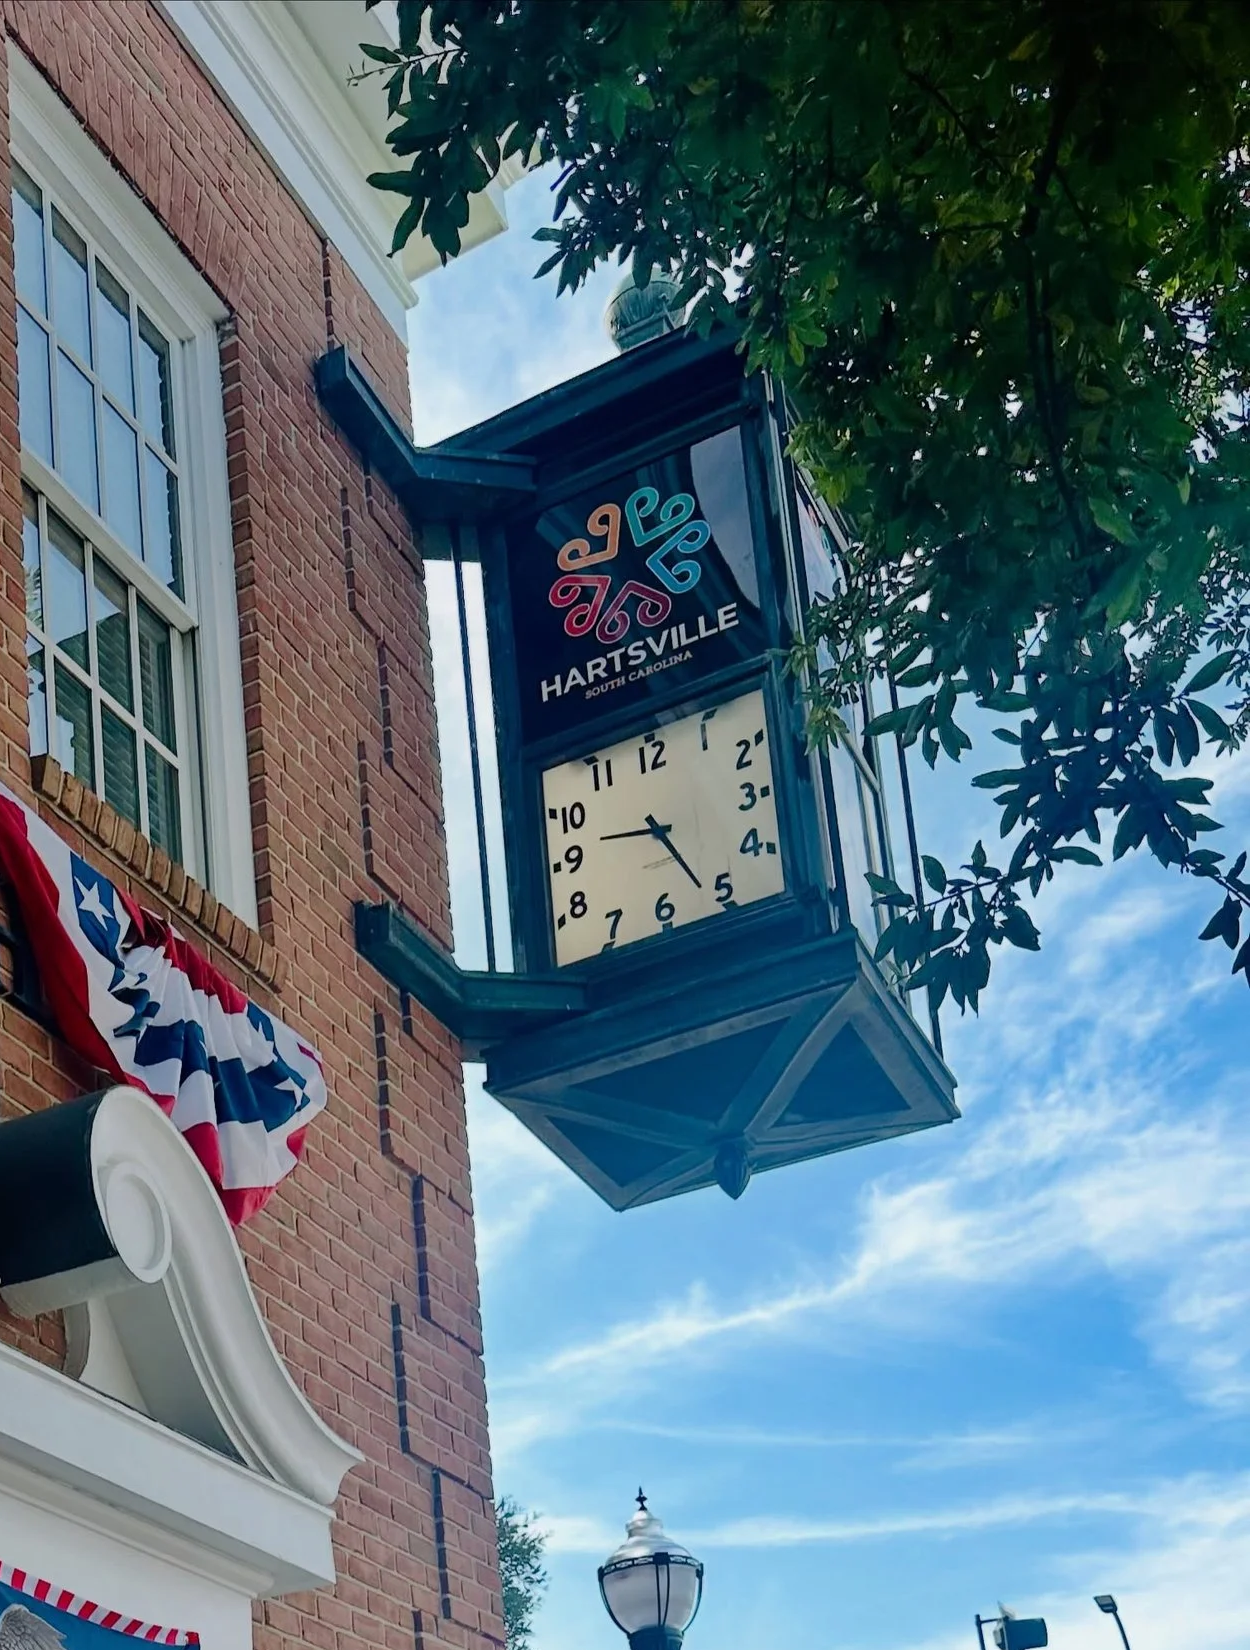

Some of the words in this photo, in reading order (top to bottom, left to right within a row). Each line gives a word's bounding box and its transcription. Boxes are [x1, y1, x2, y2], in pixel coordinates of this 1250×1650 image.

[541, 602, 739, 702] HARTSVILLE
[585, 676, 626, 700] SOUTH
[628, 650, 693, 681] CAROLINA
[700, 723, 708, 751] 1
[638, 740, 666, 774] 12
[735, 739, 752, 770] 2
[592, 759, 613, 791] 11
[738, 782, 757, 811] 3
[561, 801, 586, 834] 10
[739, 827, 763, 857] 4
[564, 844, 583, 874] 9
[714, 872, 733, 902] 5
[569, 890, 588, 919] 8
[655, 892, 675, 922] 6
[605, 908, 623, 940] 7
